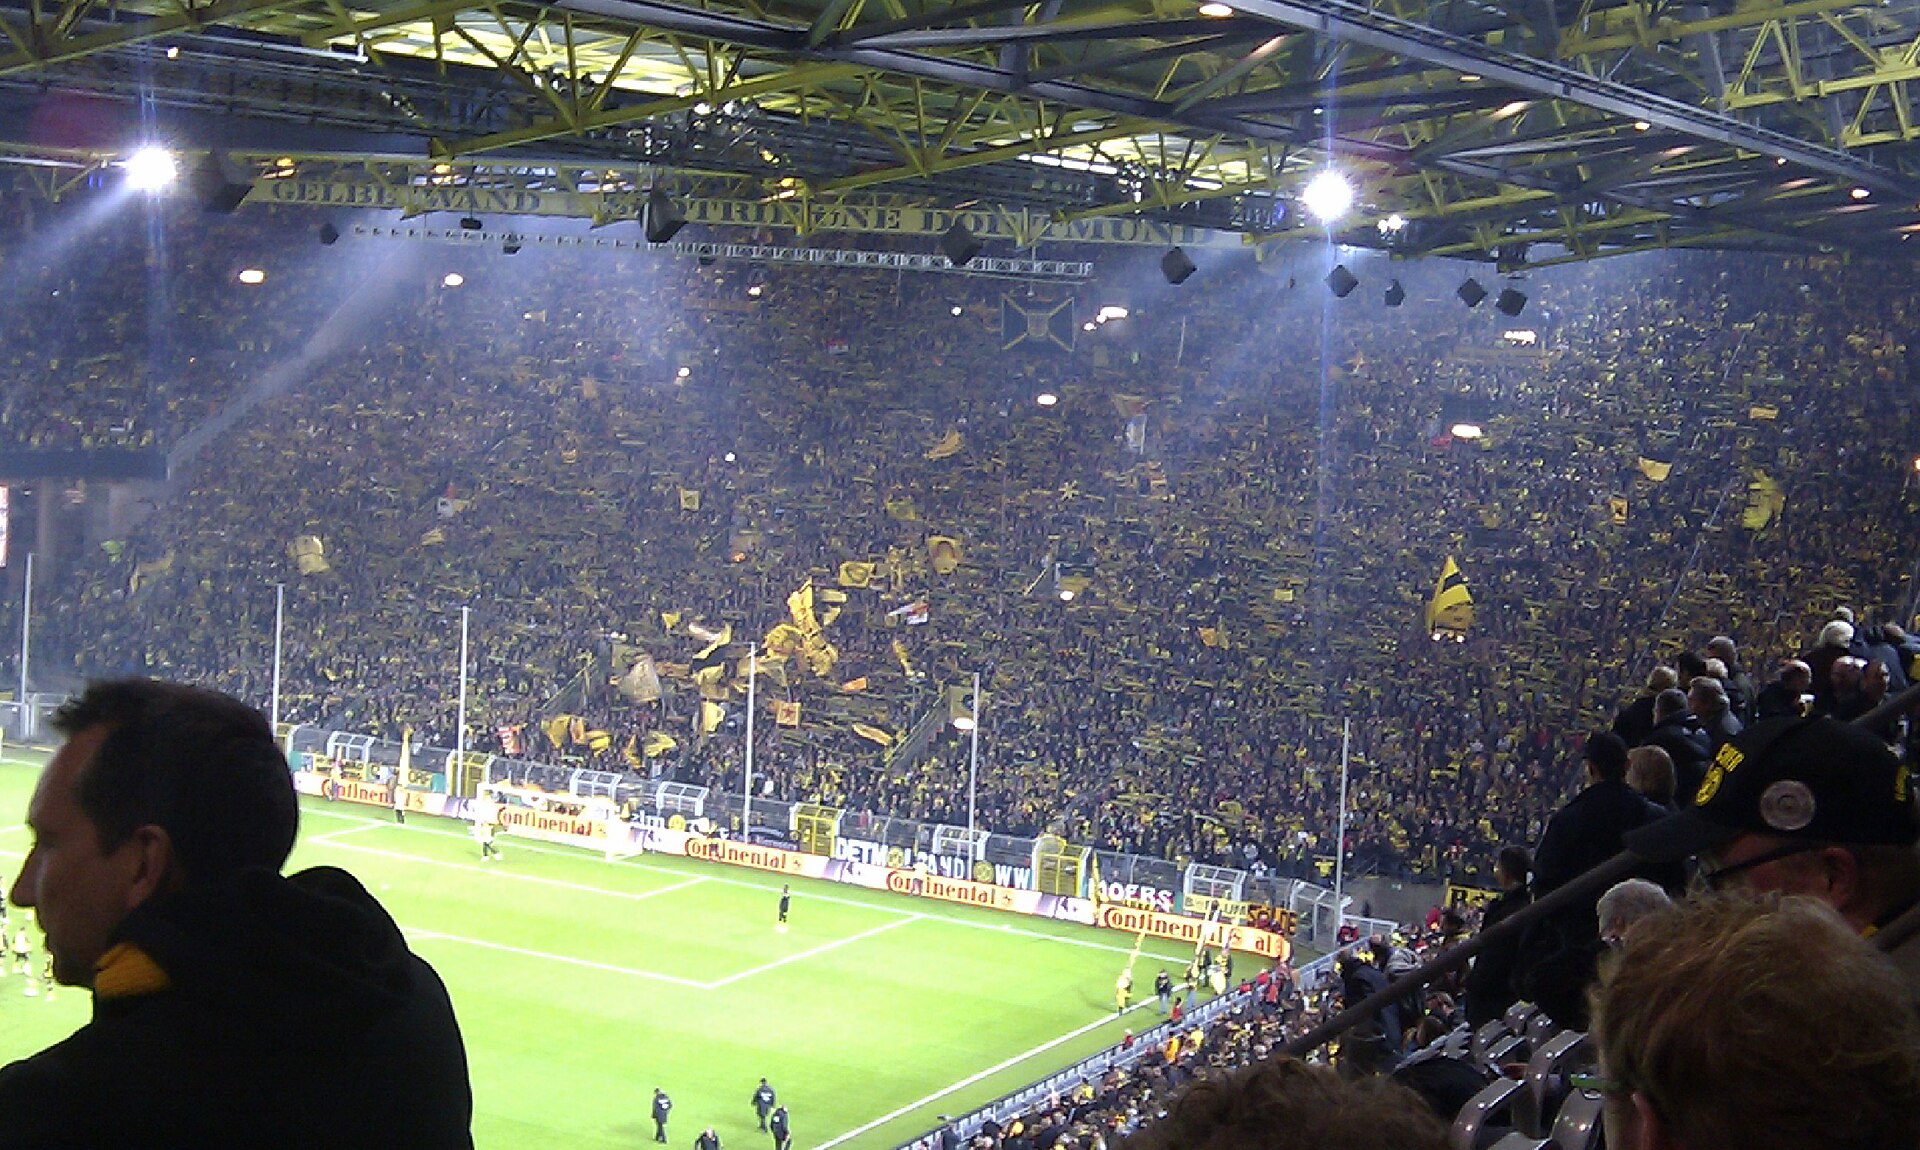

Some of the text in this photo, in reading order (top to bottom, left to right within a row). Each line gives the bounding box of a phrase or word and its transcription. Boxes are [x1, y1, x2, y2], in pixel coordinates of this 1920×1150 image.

[412, 187, 541, 212] WAND
[496, 806, 593, 837] Continental
[685, 837, 787, 869] Coninental
[885, 870, 996, 905] Coninental
